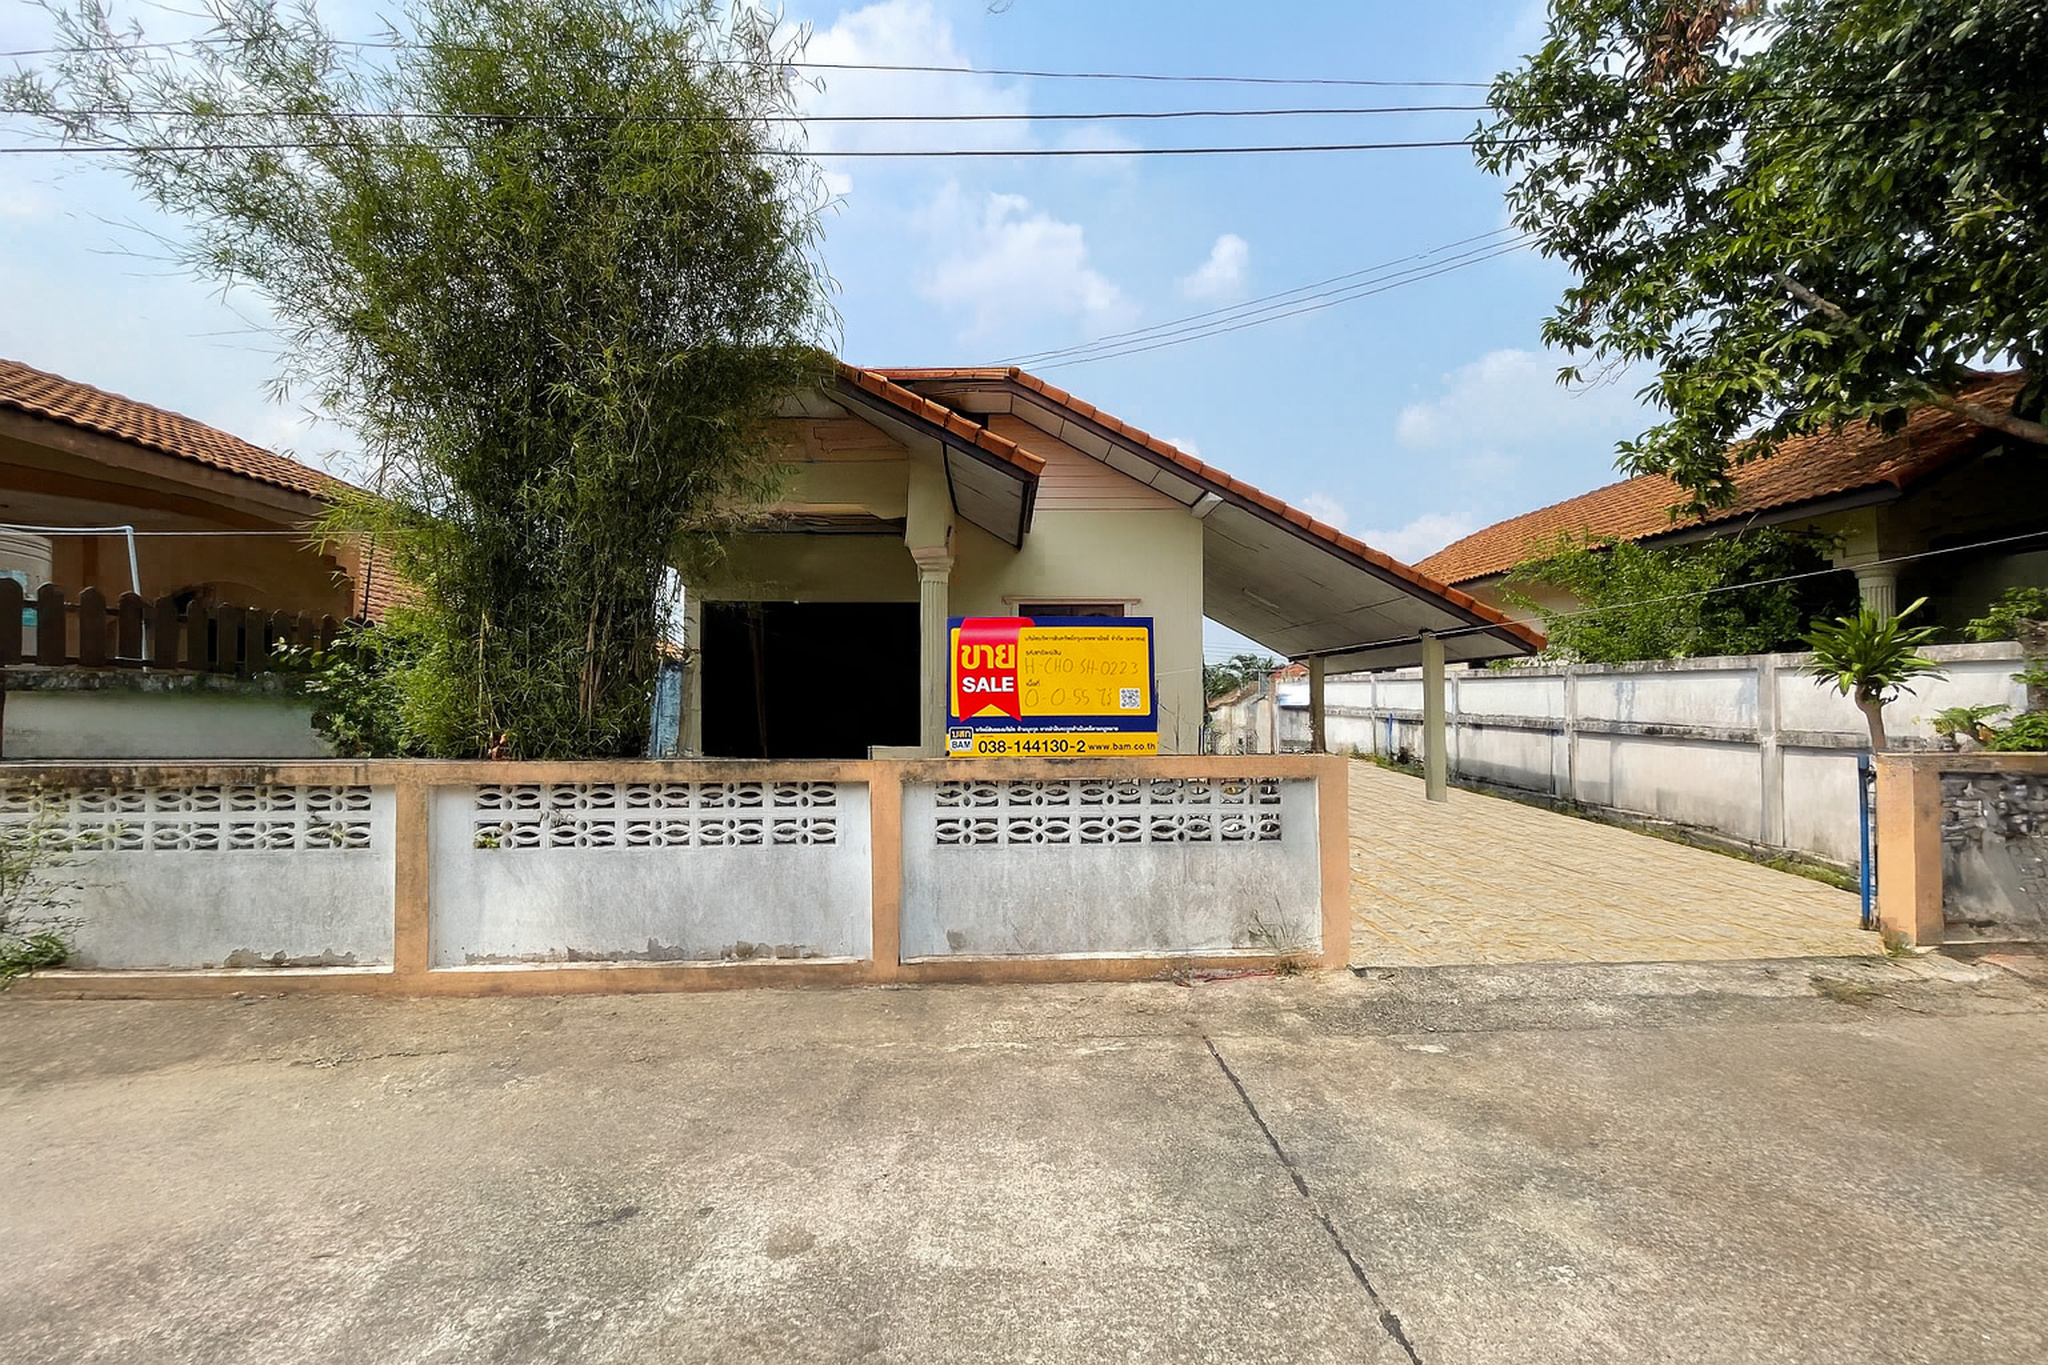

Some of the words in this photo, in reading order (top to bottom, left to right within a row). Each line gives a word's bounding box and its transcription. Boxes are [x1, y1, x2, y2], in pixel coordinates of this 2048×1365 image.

[961, 644, 1015, 669] ขาย
[962, 676, 1014, 693] SALE
[951, 740, 972, 749] BAM
[978, 739, 1086, 754] 038-144130-2
[1088, 742, 1156, 751] www.bam.co.th
